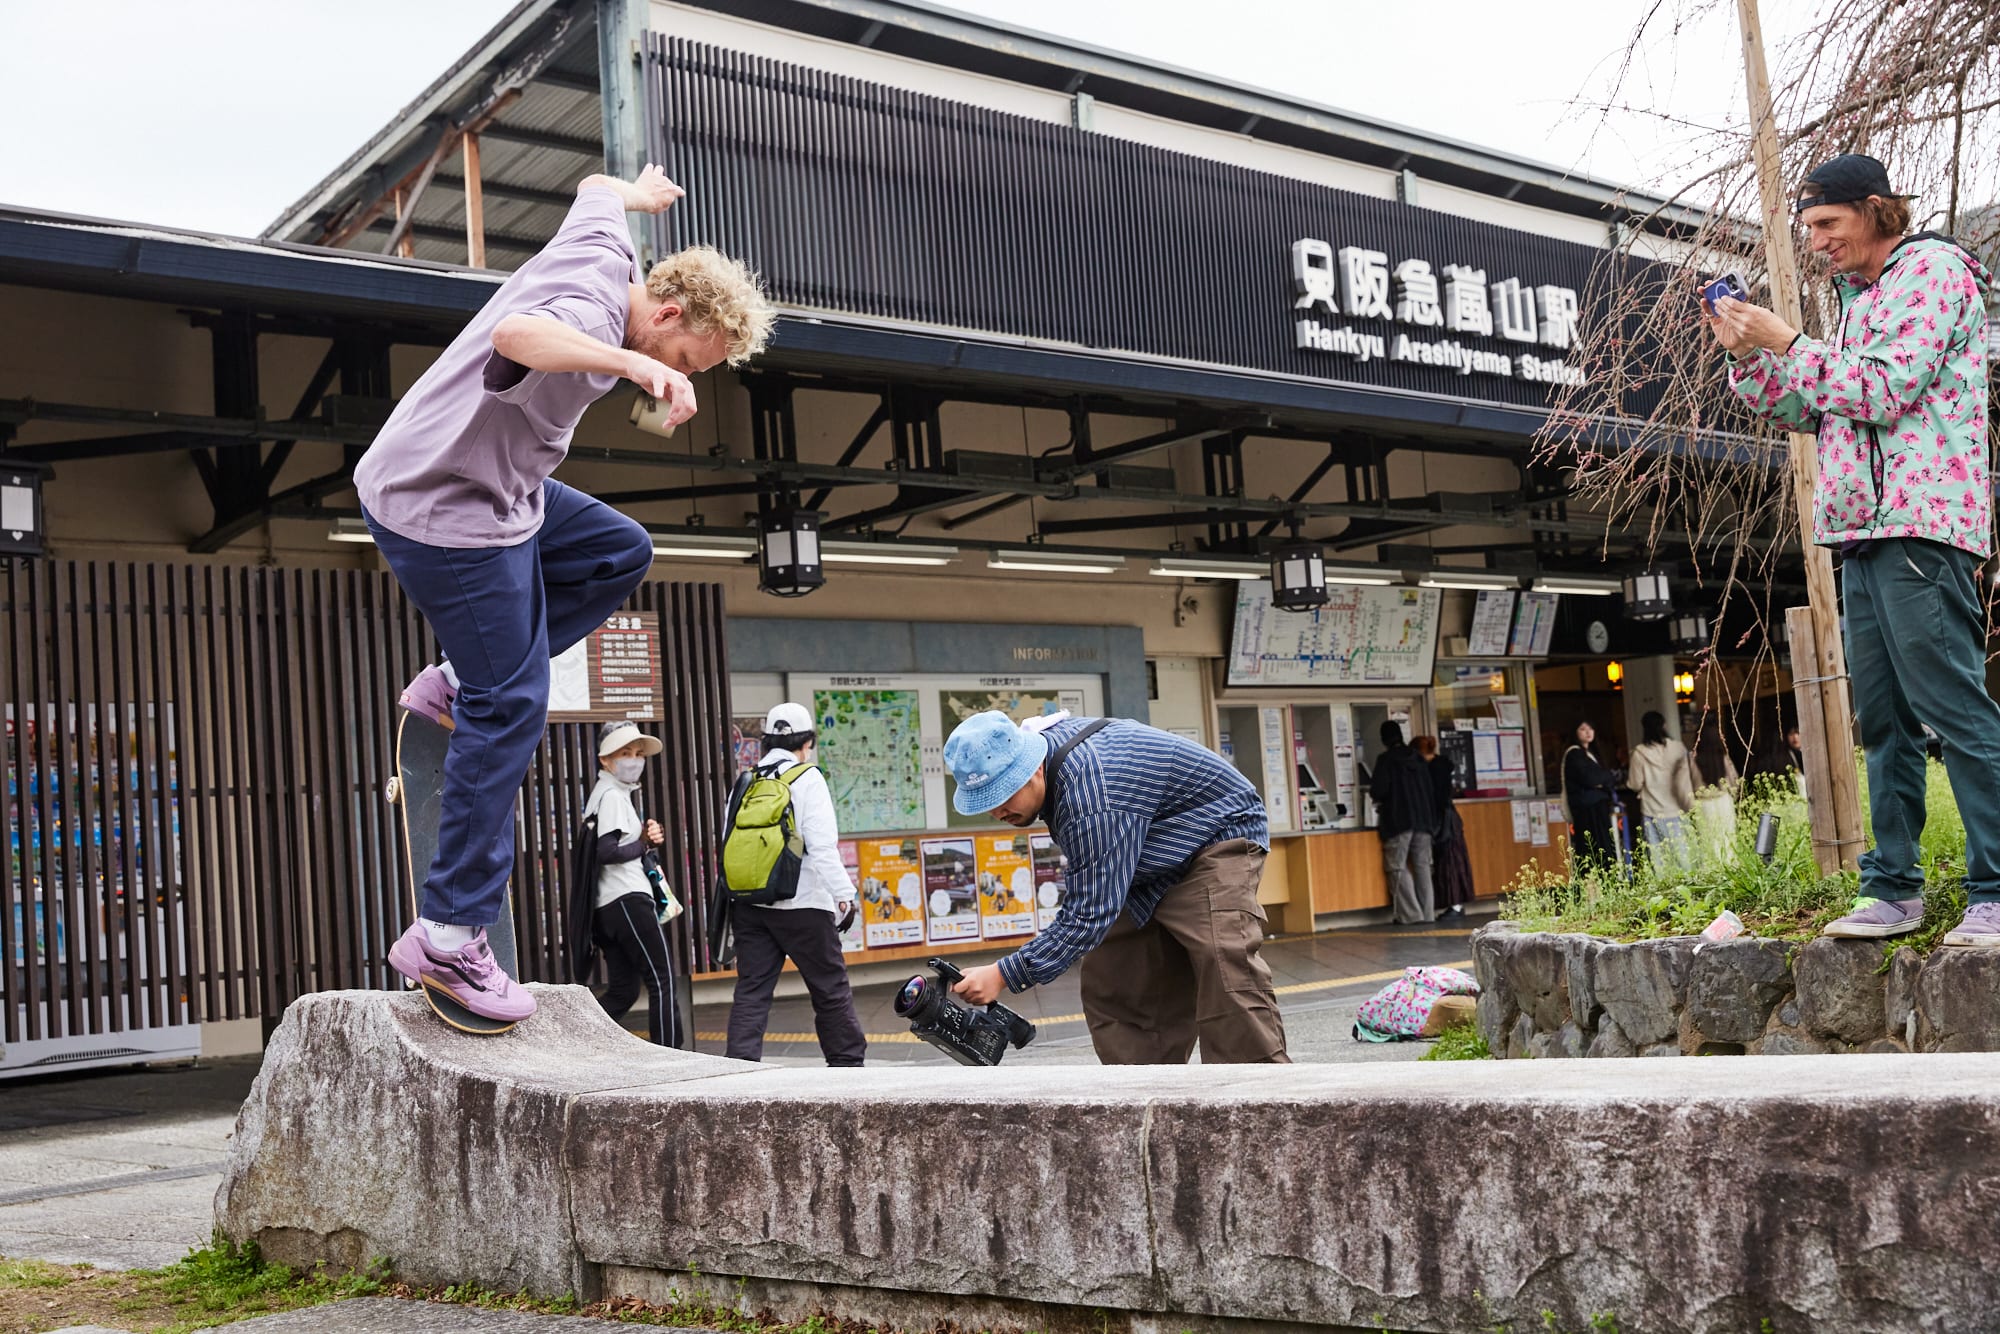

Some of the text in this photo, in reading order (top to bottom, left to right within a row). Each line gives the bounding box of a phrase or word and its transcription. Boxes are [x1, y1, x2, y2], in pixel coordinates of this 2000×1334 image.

[1339, 246, 1584, 351] 阪急嵐山駅
[1299, 319, 1586, 387] Hankyu Arashiyama Station
